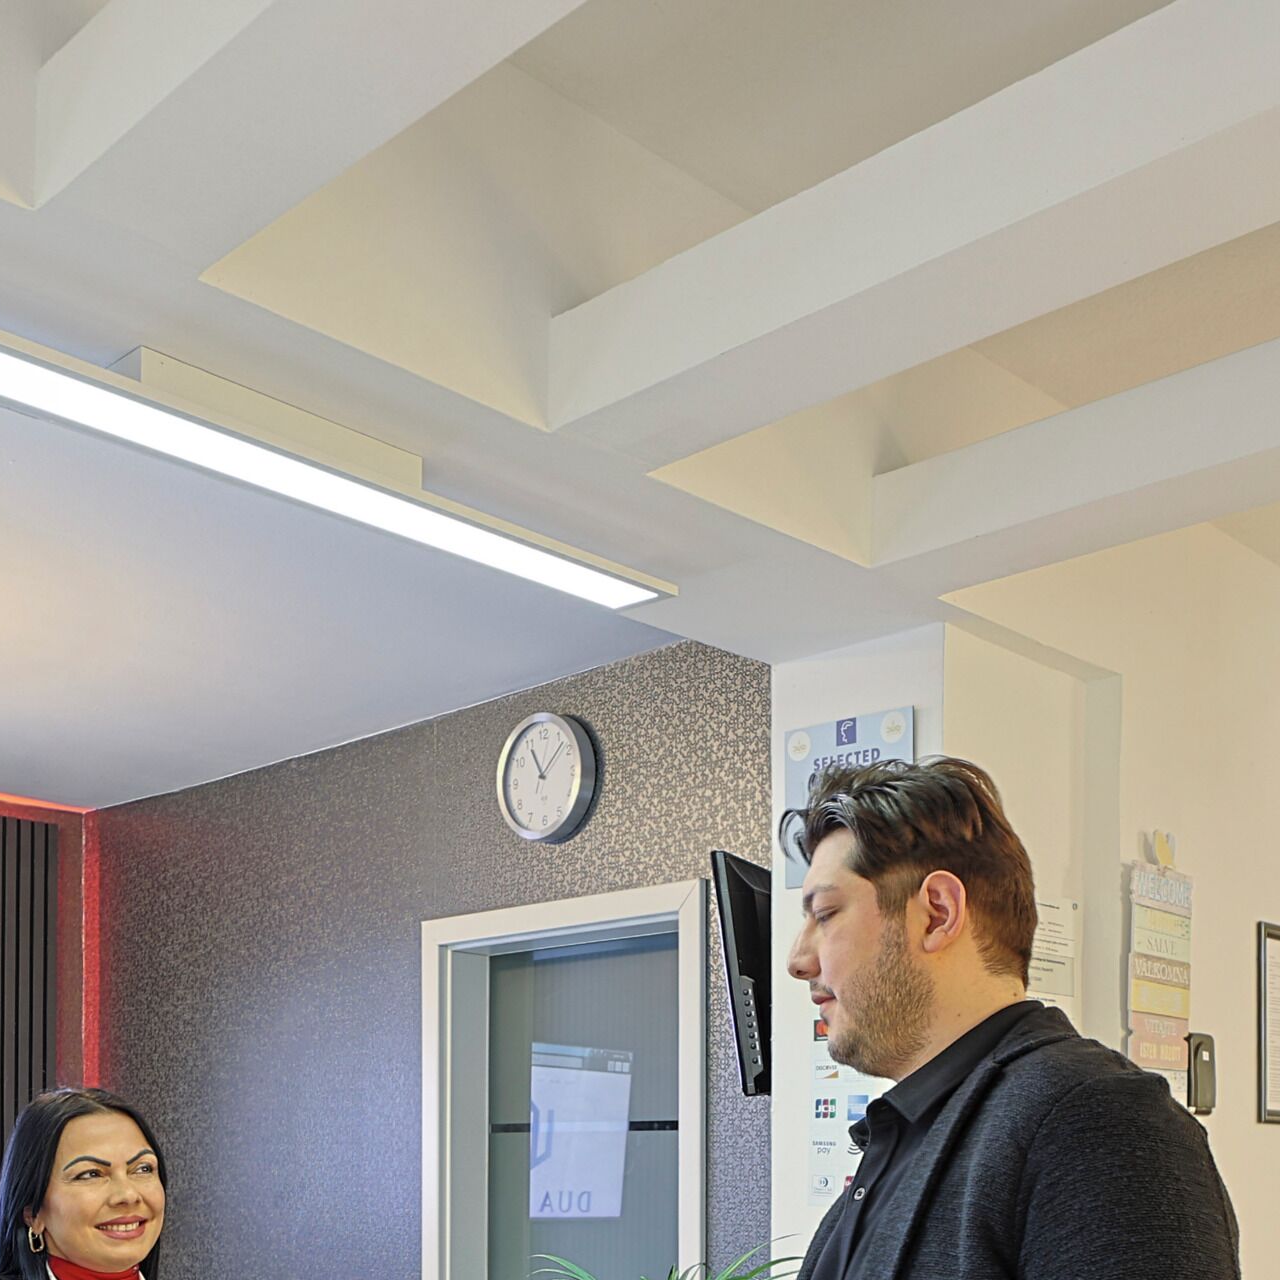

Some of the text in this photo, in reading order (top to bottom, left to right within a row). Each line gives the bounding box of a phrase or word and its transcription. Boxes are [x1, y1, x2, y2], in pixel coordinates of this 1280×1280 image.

[539, 728, 548, 740] 12
[526, 739, 534, 750] 11
[566, 744, 573, 756] 2
[515, 757, 525, 768] 10
[1135, 872, 1191, 907] WELCOME
